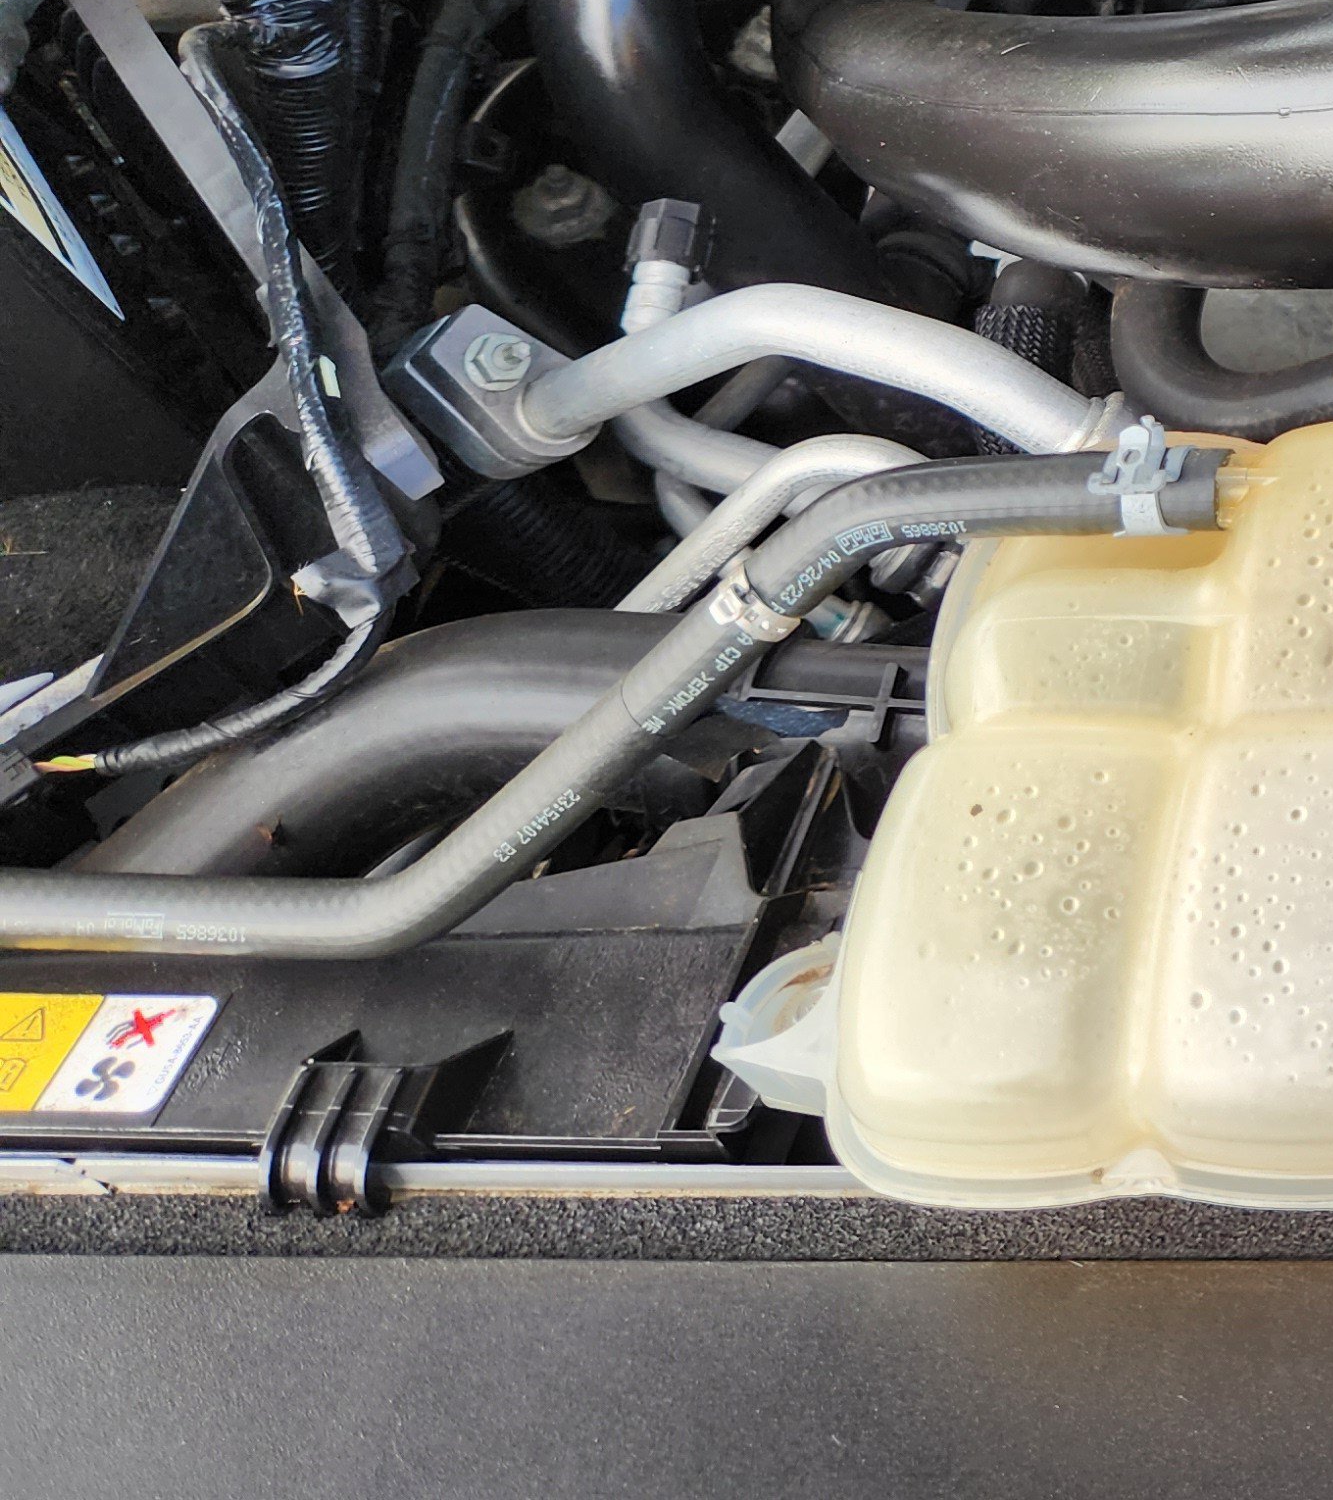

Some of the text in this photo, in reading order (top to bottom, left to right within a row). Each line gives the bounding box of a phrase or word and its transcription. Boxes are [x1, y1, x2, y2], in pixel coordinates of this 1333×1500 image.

[780, 520, 967, 606] 1036865 FoMoCo 04/26/23
[714, 647, 742, 672] CIP
[516, 788, 581, 845] 23:54:07
[175, 923, 248, 943] 1036865
